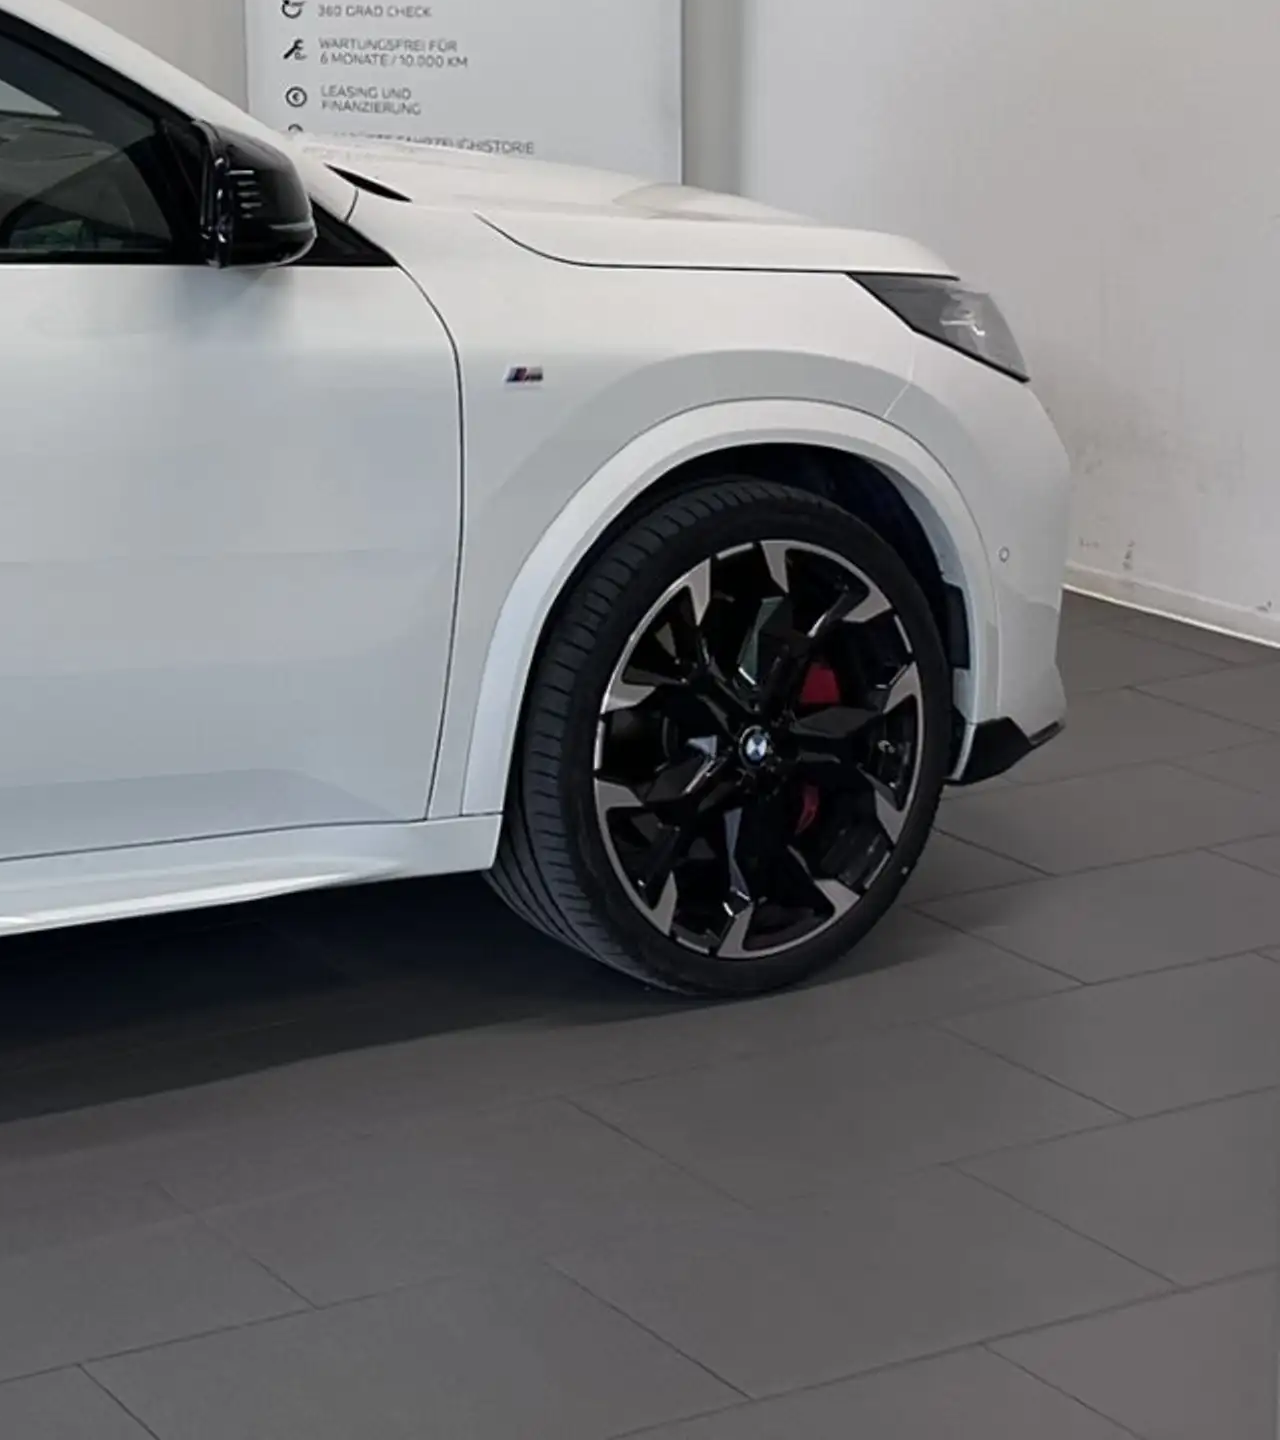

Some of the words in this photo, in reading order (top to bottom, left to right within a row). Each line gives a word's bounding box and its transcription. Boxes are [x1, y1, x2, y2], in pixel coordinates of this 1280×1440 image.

[345, 4, 383, 18] GRAD
[386, 5, 432, 18] CHECK
[428, 37, 458, 52] FÜR
[331, 53, 389, 67] MONATE
[321, 85, 378, 99] LEASING
[381, 86, 412, 100] UND
